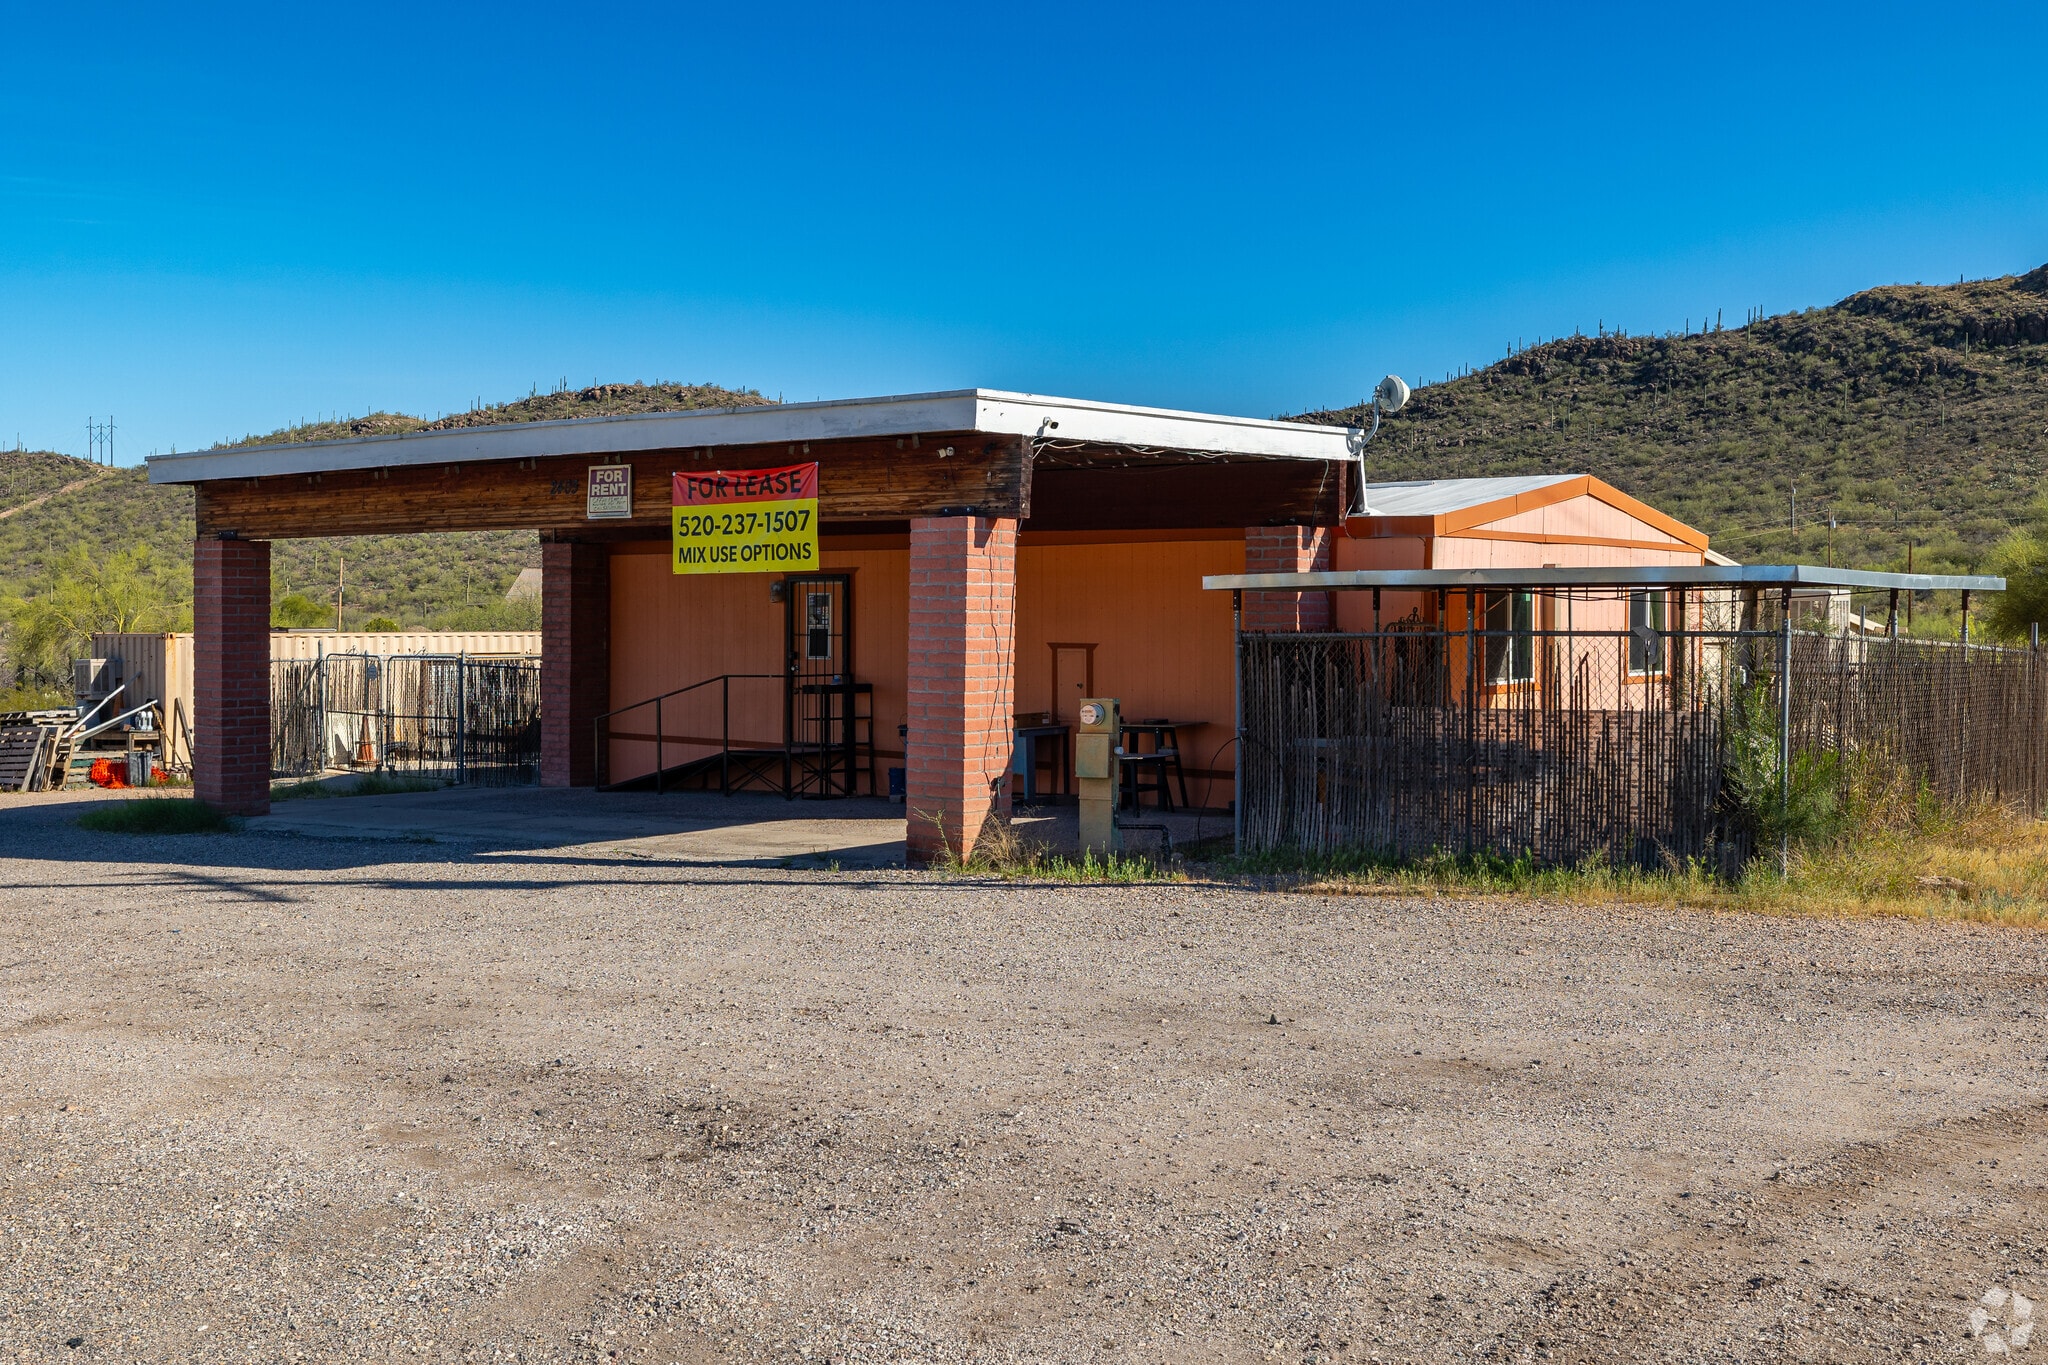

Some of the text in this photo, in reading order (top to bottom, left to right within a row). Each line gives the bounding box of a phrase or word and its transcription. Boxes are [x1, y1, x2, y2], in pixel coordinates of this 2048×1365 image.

[596, 470, 623, 483] FOR
[687, 470, 801, 499] FOR LEASE
[591, 483, 627, 496] RENT
[678, 510, 811, 537] 520-237-1507
[678, 542, 812, 564] MIX USE OPTIONS
